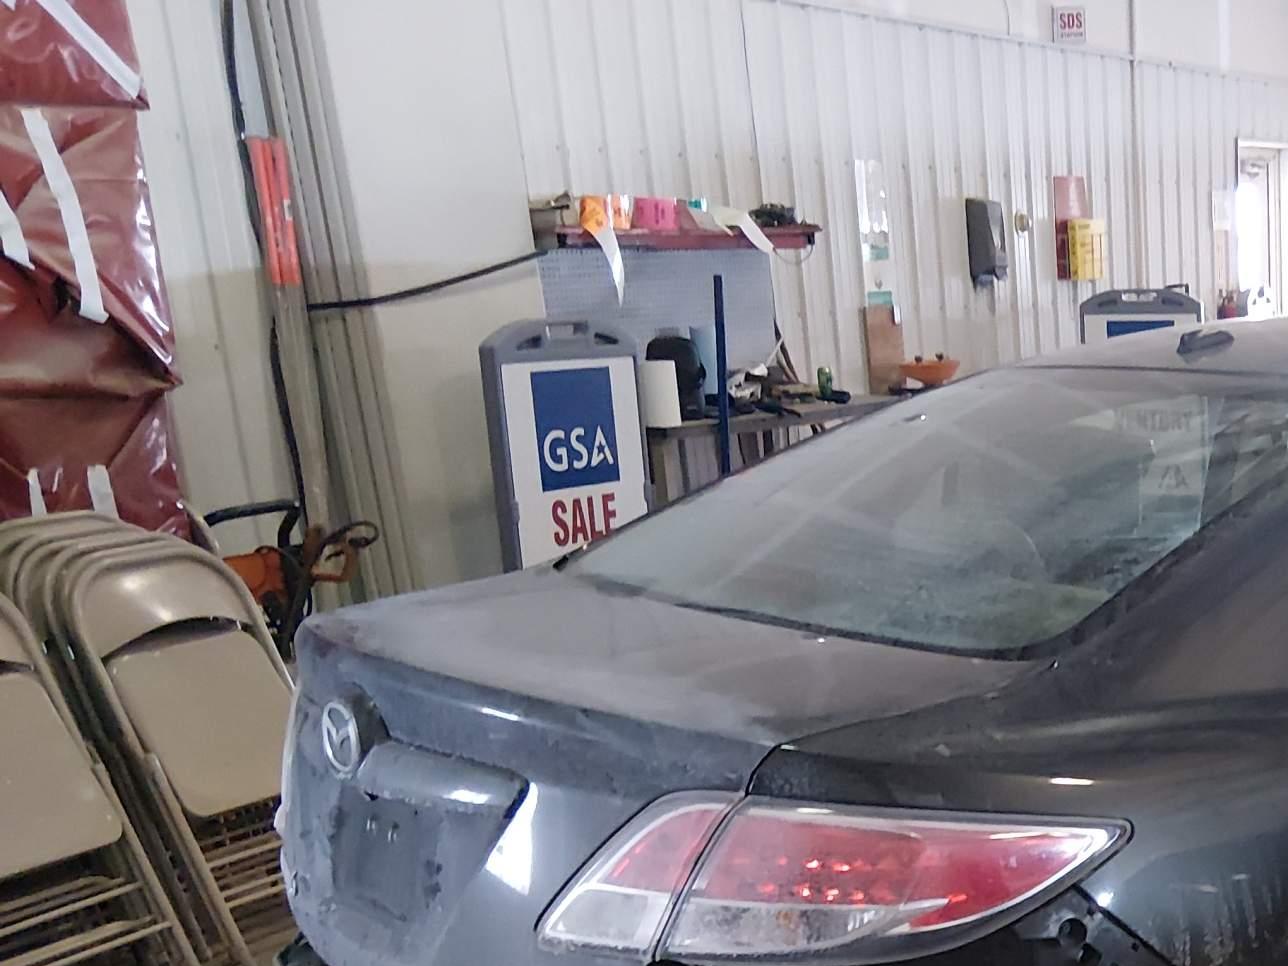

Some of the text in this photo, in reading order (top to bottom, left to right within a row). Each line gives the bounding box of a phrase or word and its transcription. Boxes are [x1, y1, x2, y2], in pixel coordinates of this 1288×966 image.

[1060, 12, 1082, 30] SDS
[543, 425, 614, 472] GSA
[551, 492, 617, 547] SALE
